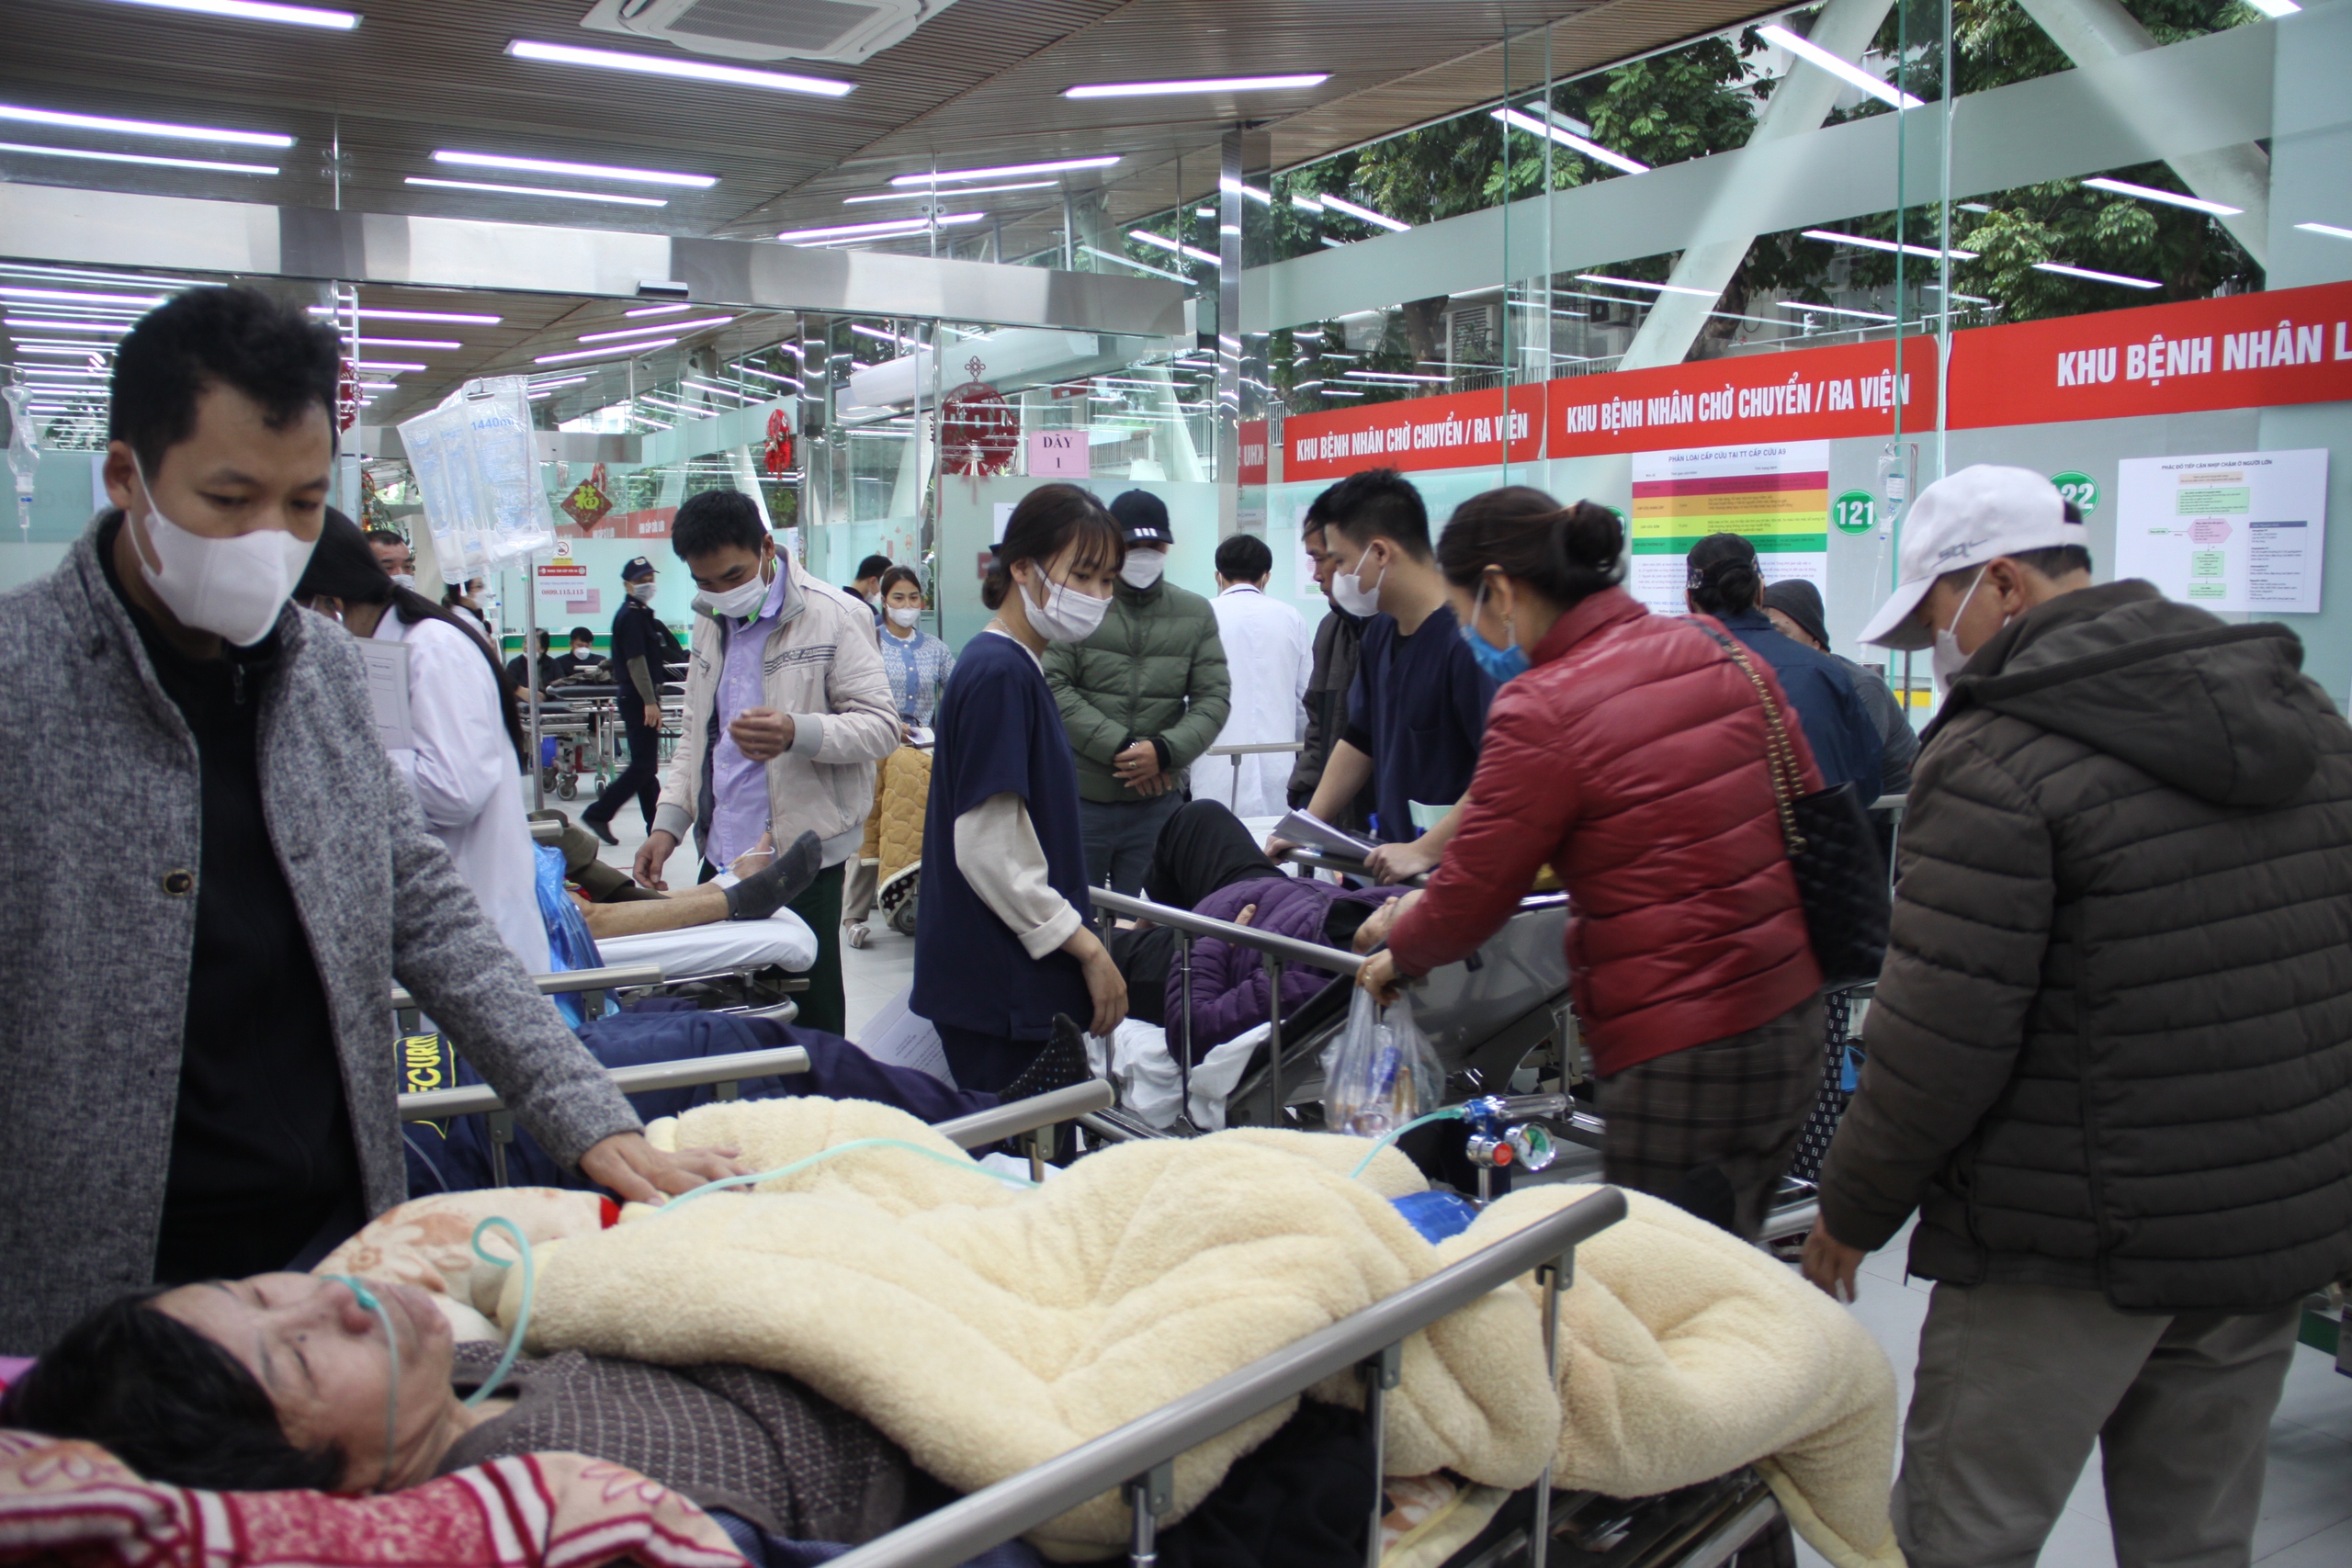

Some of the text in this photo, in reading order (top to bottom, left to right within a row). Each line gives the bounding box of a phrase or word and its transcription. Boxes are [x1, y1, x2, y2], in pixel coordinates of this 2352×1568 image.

[2057, 346, 2117, 387] KHU
[2126, 333, 2212, 387] BỆNH
[2222, 319, 2324, 371] NHÂN
[1566, 368, 1910, 435] KHU BỆNH NHÂN CHỜ CHUYỂN / RA VIỆN
[1043, 434, 1073, 449] DÃY
[1296, 438, 1317, 462] KHU
[1320, 431, 1349, 464] BỆNH
[1351, 425, 1385, 456] NHÂN
[1386, 421, 1411, 453] CHỜ
[1413, 411, 1463, 450] CHUYỂN
[1474, 418, 1492, 444] RA
[1495, 409, 1528, 446] VIỆN
[1056, 457, 1061, 468] 1
[573, 484, 600, 510] 福
[2061, 483, 2095, 509] 22
[1837, 501, 1874, 525] 121
